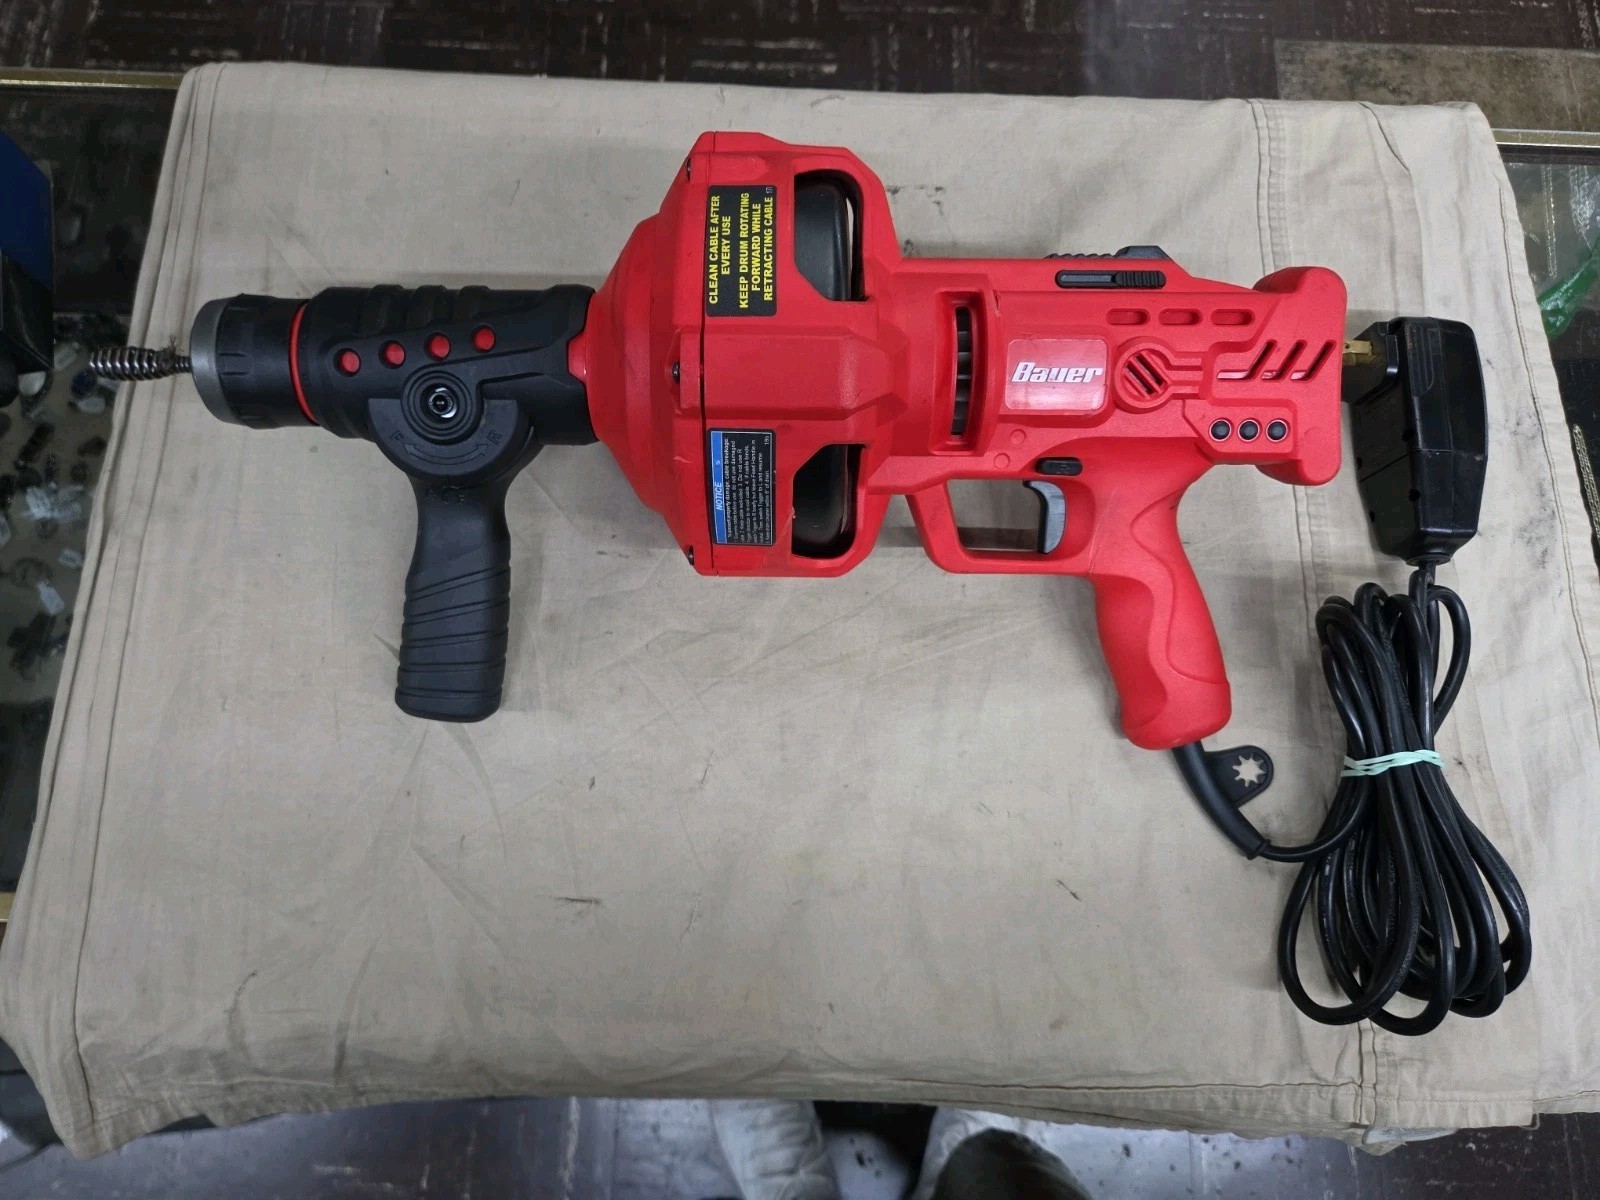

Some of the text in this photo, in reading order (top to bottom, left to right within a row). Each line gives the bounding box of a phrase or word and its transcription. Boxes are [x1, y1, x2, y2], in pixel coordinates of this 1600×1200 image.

[709, 195, 720, 304] CLEAN CABLE AFTER
[721, 215, 731, 275] EVERY USE
[739, 192, 749, 308] KEEP DRUM ROTATING
[751, 203, 760, 291] FORWARD WHILE
[763, 196, 773, 301] RETRACTING CABLE
[1011, 361, 1103, 383] Bauer
[487, 429, 503, 445] R
[714, 482, 723, 510] NOTICE
